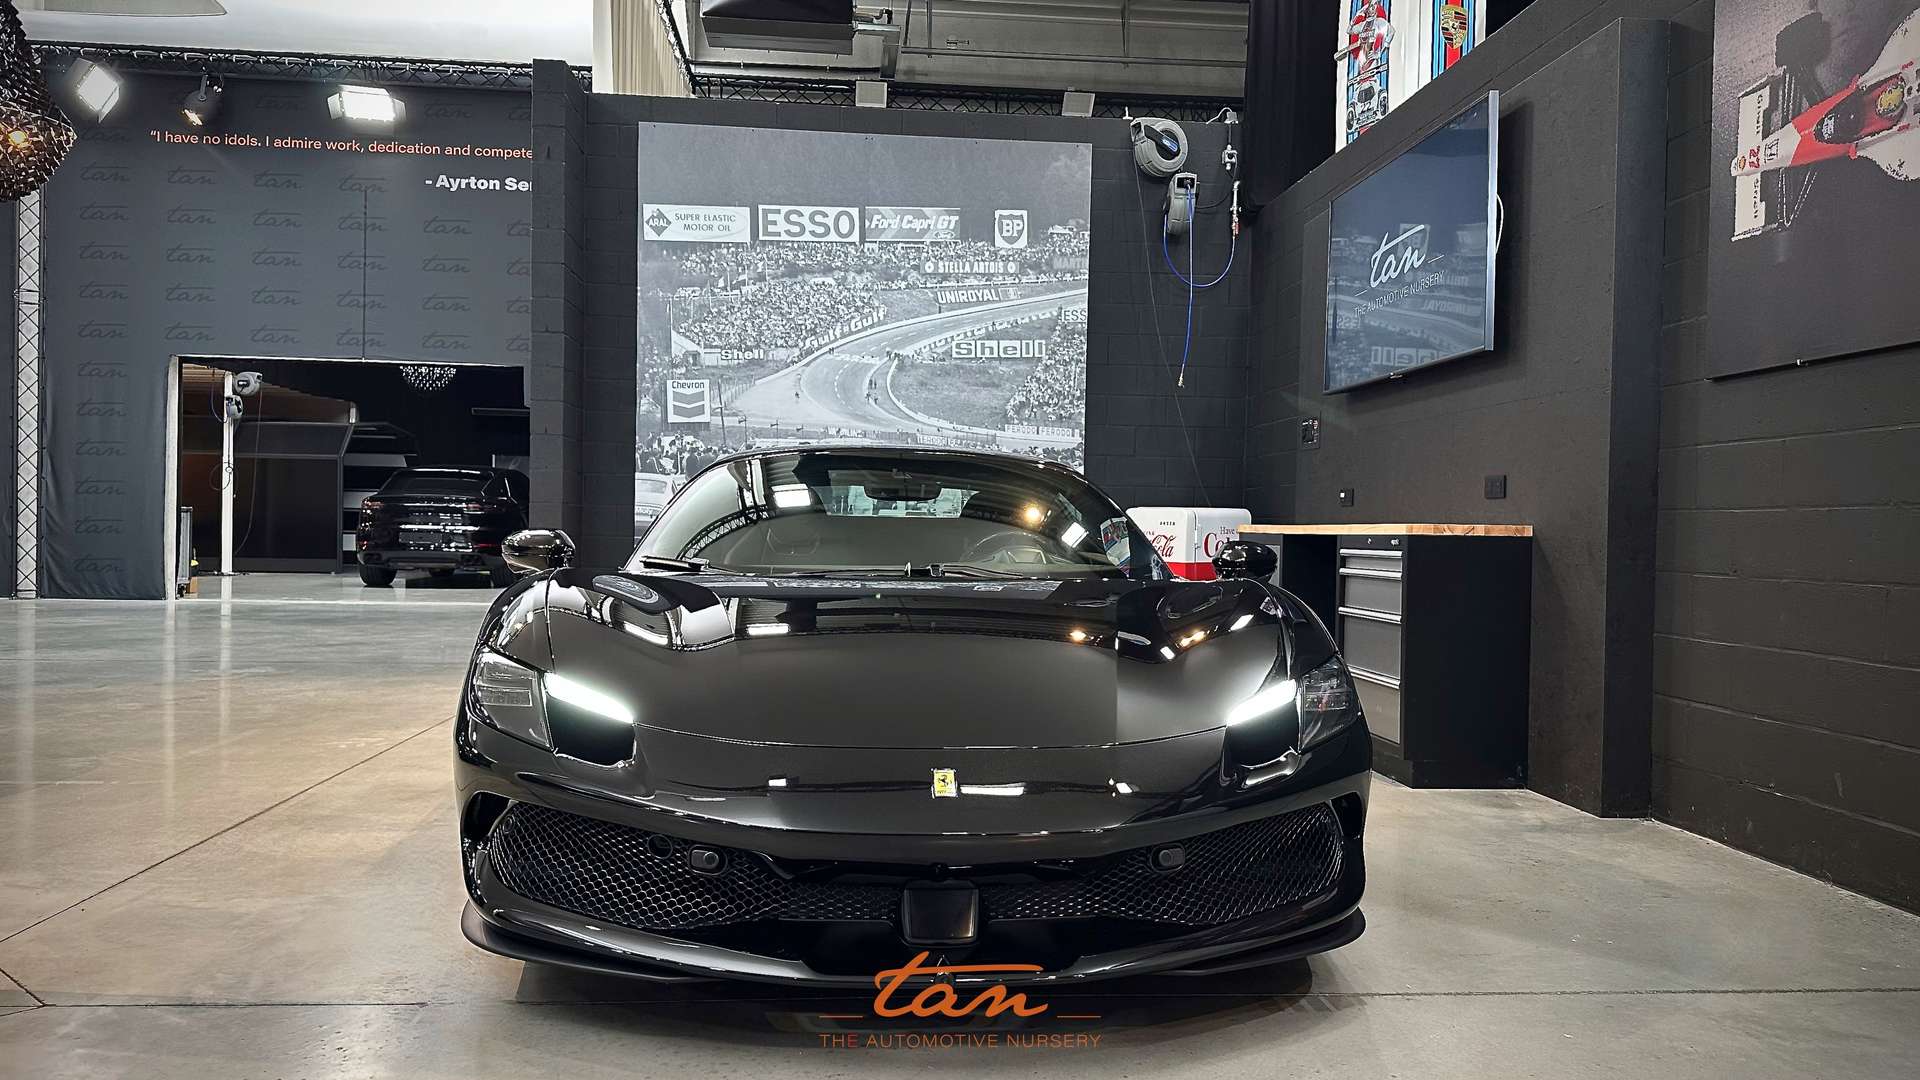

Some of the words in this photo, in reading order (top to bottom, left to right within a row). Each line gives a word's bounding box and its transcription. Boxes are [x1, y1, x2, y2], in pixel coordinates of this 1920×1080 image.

[1360, 102, 1373, 114] 22
[165, 131, 199, 144] have
[203, 135, 221, 145] no
[225, 134, 262, 147] idols.
[273, 136, 322, 149] admire
[326, 140, 365, 153] work,
[368, 141, 441, 155] dedication
[445, 143, 471, 156] and
[80, 161, 130, 182] tan
[167, 165, 217, 185] tan
[253, 170, 302, 189] tan
[338, 174, 388, 193] tan
[436, 174, 500, 192] Ayrton
[504, 177, 533, 192] Se
[79, 202, 129, 221] tan
[167, 204, 217, 224] tan
[252, 208, 302, 228] tan
[674, 212, 700, 222] SUPER
[703, 213, 736, 223] ELASTIC
[337, 213, 388, 232] tan
[423, 215, 473, 235] tan
[648, 219, 668, 227] ARAL
[683, 223, 714, 232] MOTOR
[717, 223, 731, 232] OIL
[761, 208, 856, 239] ESSO
[870, 214, 899, 230] Ford
[901, 214, 935, 233] Capri
[937, 215, 960, 230] GT
[1001, 219, 1024, 238] BP
[79, 241, 129, 261] tan
[166, 243, 216, 264] tan
[251, 247, 301, 266] tan
[337, 251, 388, 270] tan
[1369, 224, 1426, 288] tan
[422, 254, 472, 273] tan
[937, 261, 971, 274] STELLA
[973, 261, 1004, 274] ARTOIS
[79, 281, 129, 300] tan
[166, 283, 216, 302] tan
[251, 286, 301, 306] tan
[336, 290, 387, 309] tan
[937, 288, 1000, 304] UNIROYAL
[1354, 303, 1367, 318] THE
[1367, 286, 1410, 312] AUTOMOTIVE
[1409, 270, 1445, 295] NURSERY
[421, 293, 472, 312] tan
[850, 304, 887, 332] Gulf
[78, 320, 129, 339] tan
[164, 322, 216, 341] tan
[250, 324, 301, 344] tan
[336, 328, 387, 348] tan
[421, 331, 472, 351] tan
[954, 341, 1045, 357] Shell
[721, 348, 765, 361] Shell
[77, 360, 129, 379] tan
[671, 380, 706, 390] Chevron
[76, 398, 128, 417] tan
[75, 438, 127, 456] tan
[74, 476, 126, 495] tan
[74, 516, 125, 535] tan
[1220, 526, 1235, 535] Have
[73, 554, 124, 573] tan
